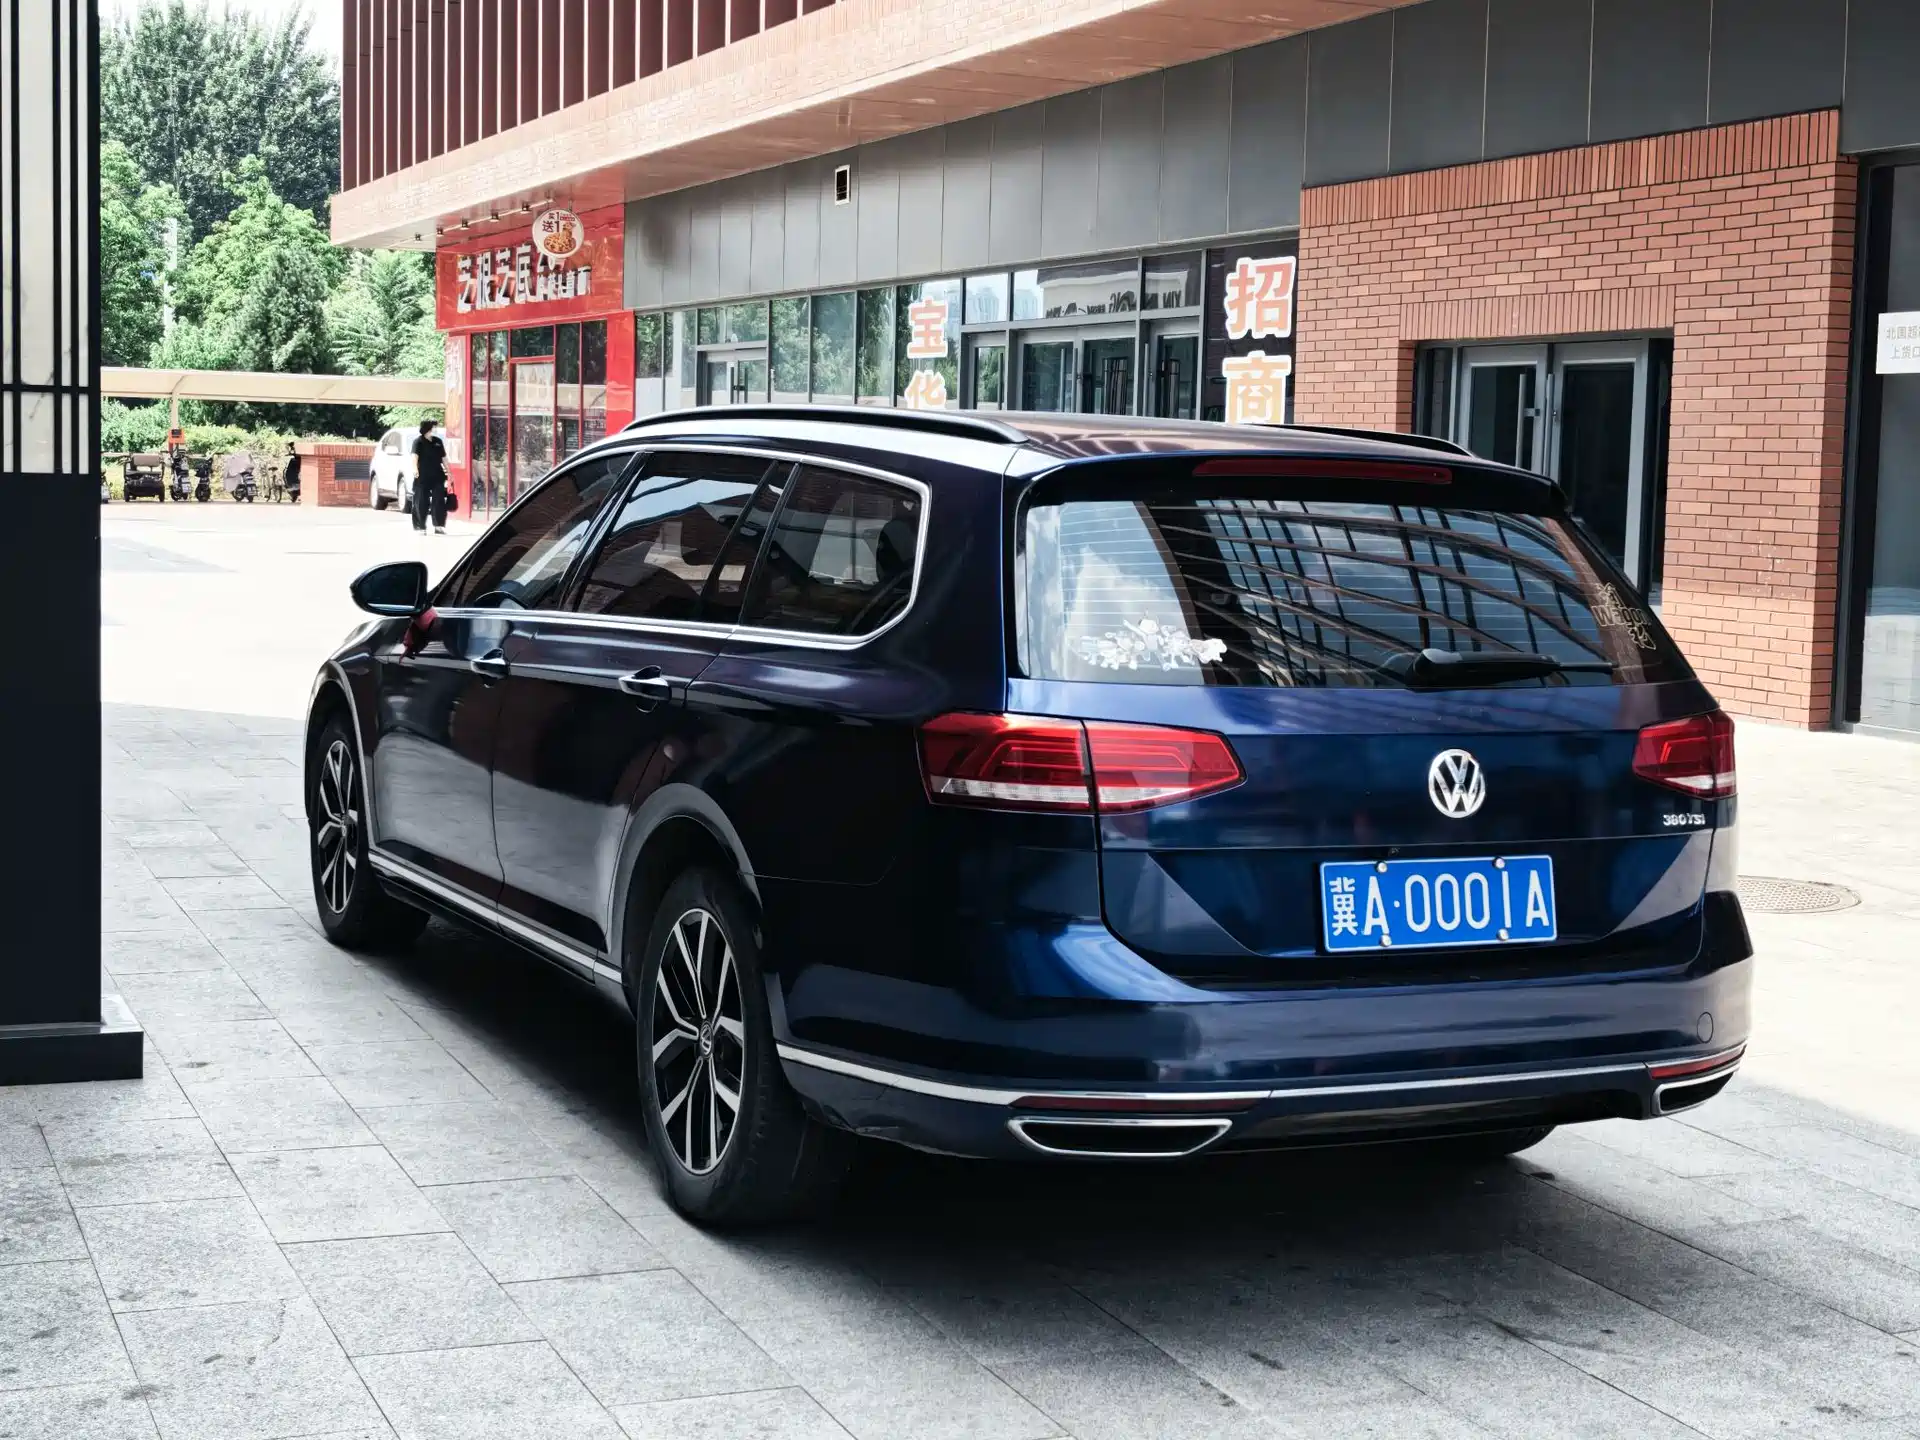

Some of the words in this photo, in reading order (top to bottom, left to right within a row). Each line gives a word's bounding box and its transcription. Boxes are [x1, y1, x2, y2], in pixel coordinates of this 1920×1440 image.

[542, 220, 560, 233] 送1
[1885, 324, 1920, 340] 北国超
